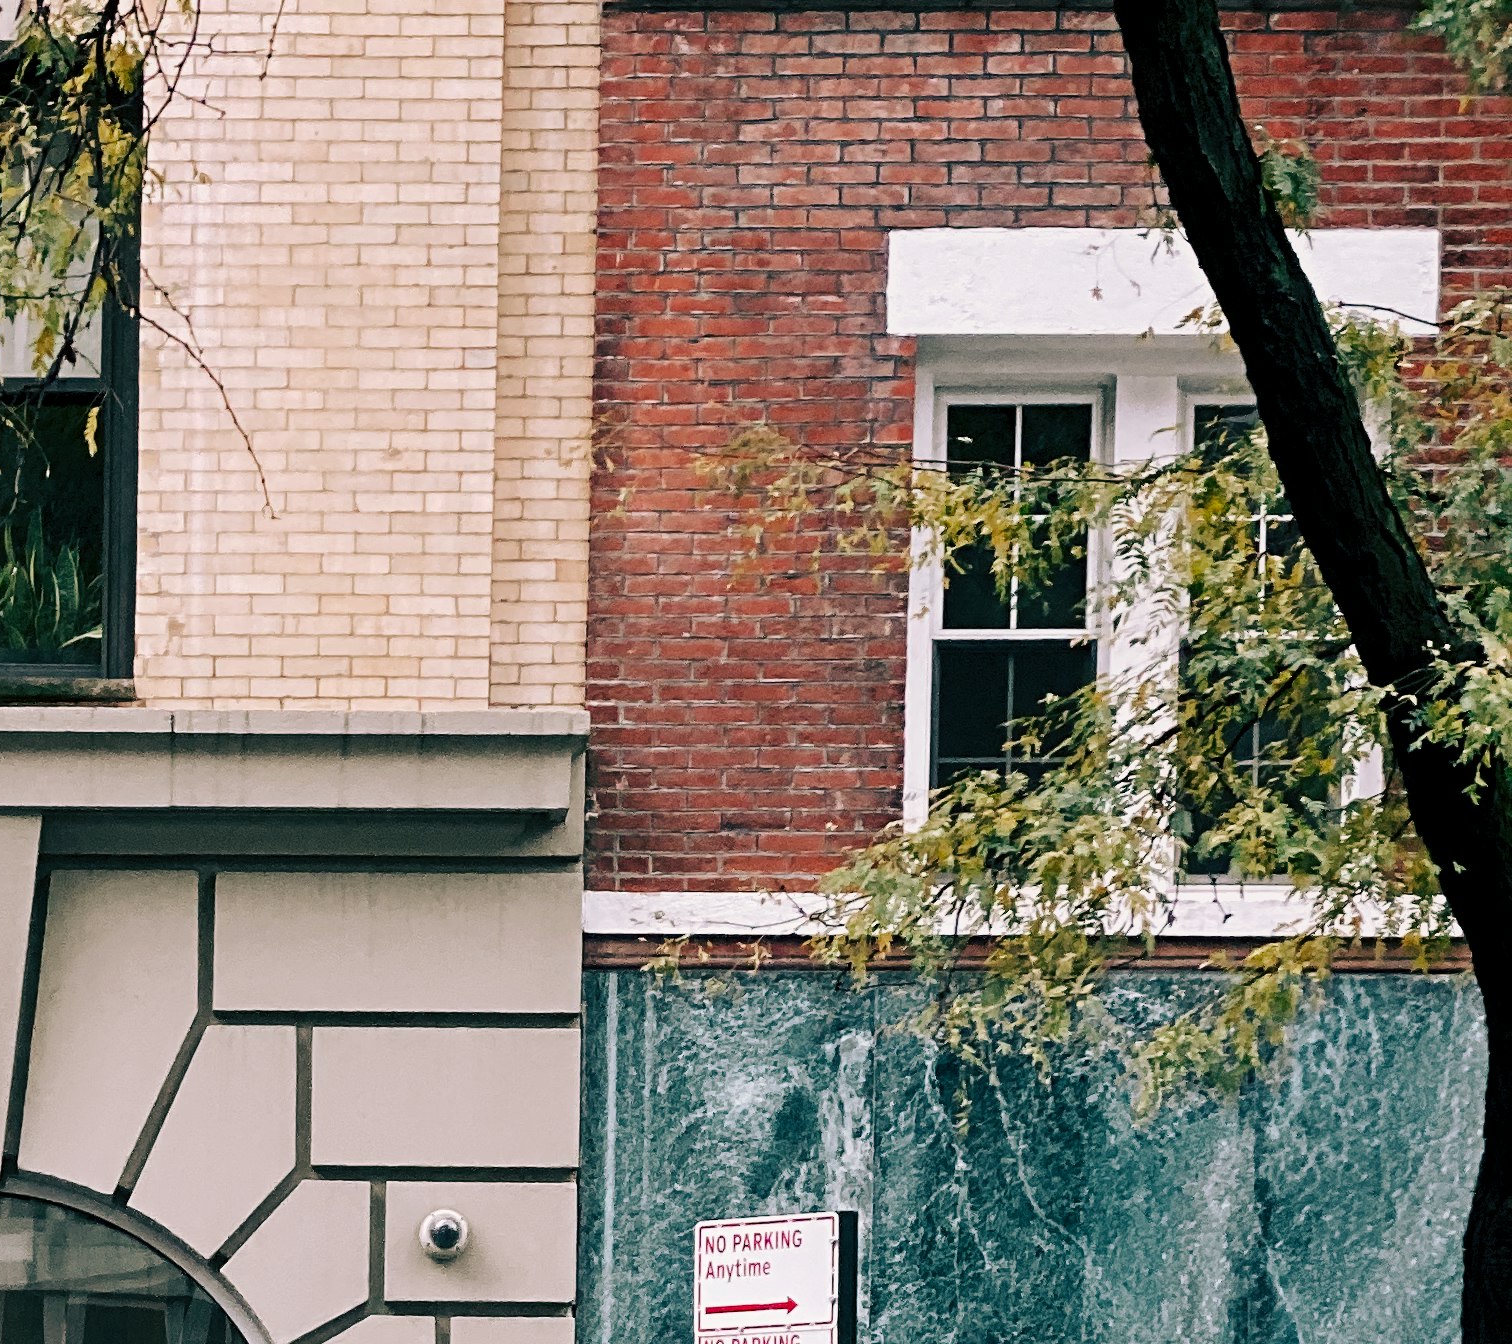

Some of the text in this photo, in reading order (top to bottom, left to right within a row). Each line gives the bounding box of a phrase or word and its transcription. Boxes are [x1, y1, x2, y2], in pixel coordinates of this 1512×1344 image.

[705, 1230, 803, 1254] NO PARKING
[705, 1258, 771, 1282] Anytime
